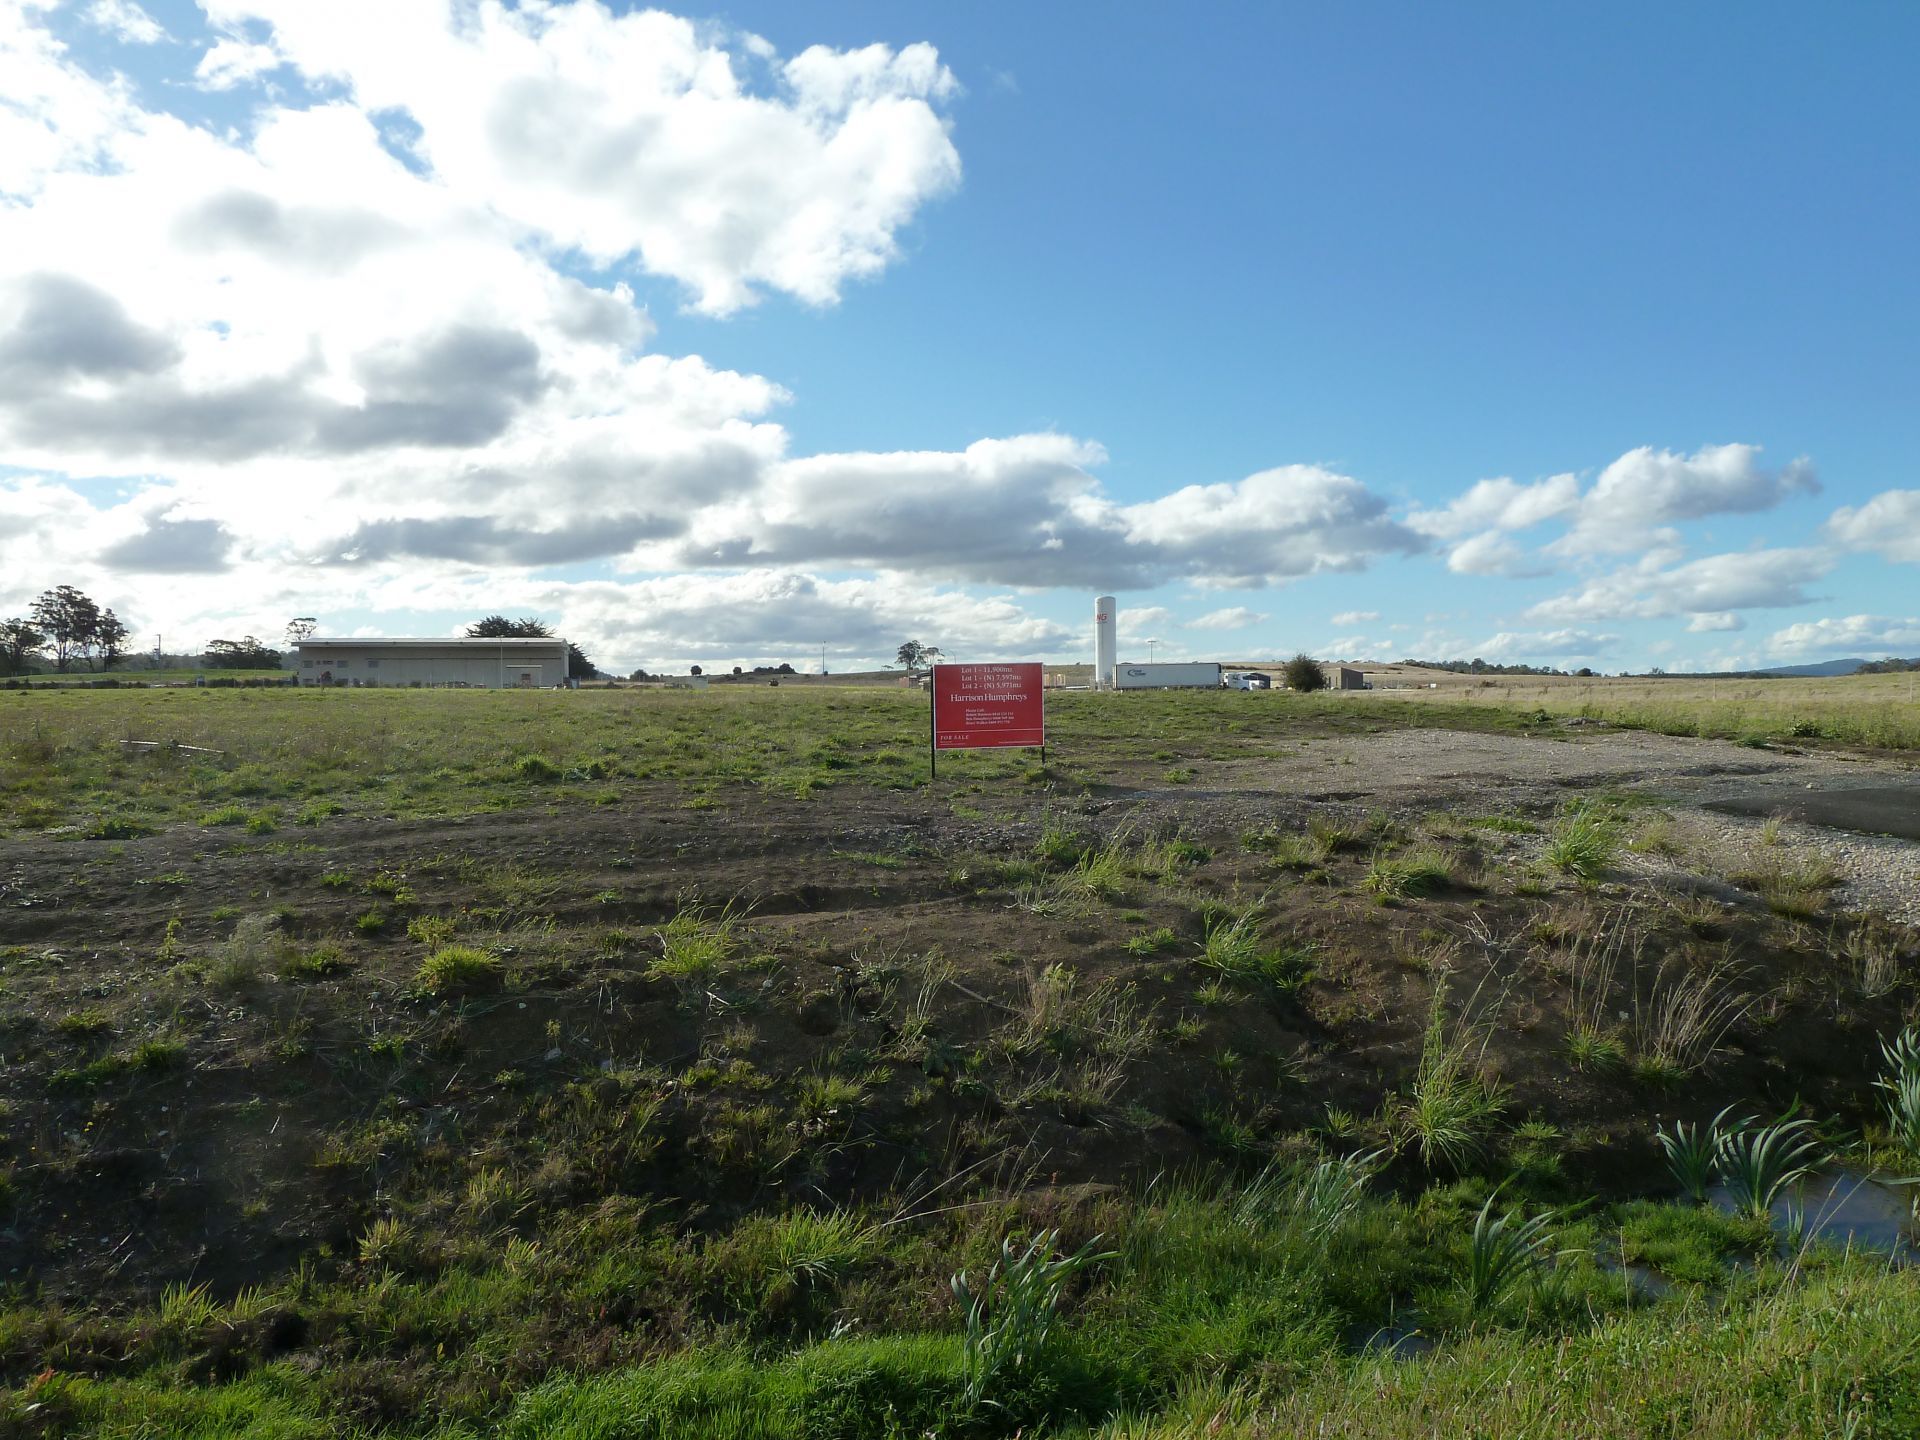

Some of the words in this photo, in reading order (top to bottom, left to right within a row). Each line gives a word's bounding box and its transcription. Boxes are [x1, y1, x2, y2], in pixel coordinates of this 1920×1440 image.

[983, 682, 995, 690] (N)
[950, 693, 984, 702] Harrison
[984, 692, 1028, 703] Humphreys
